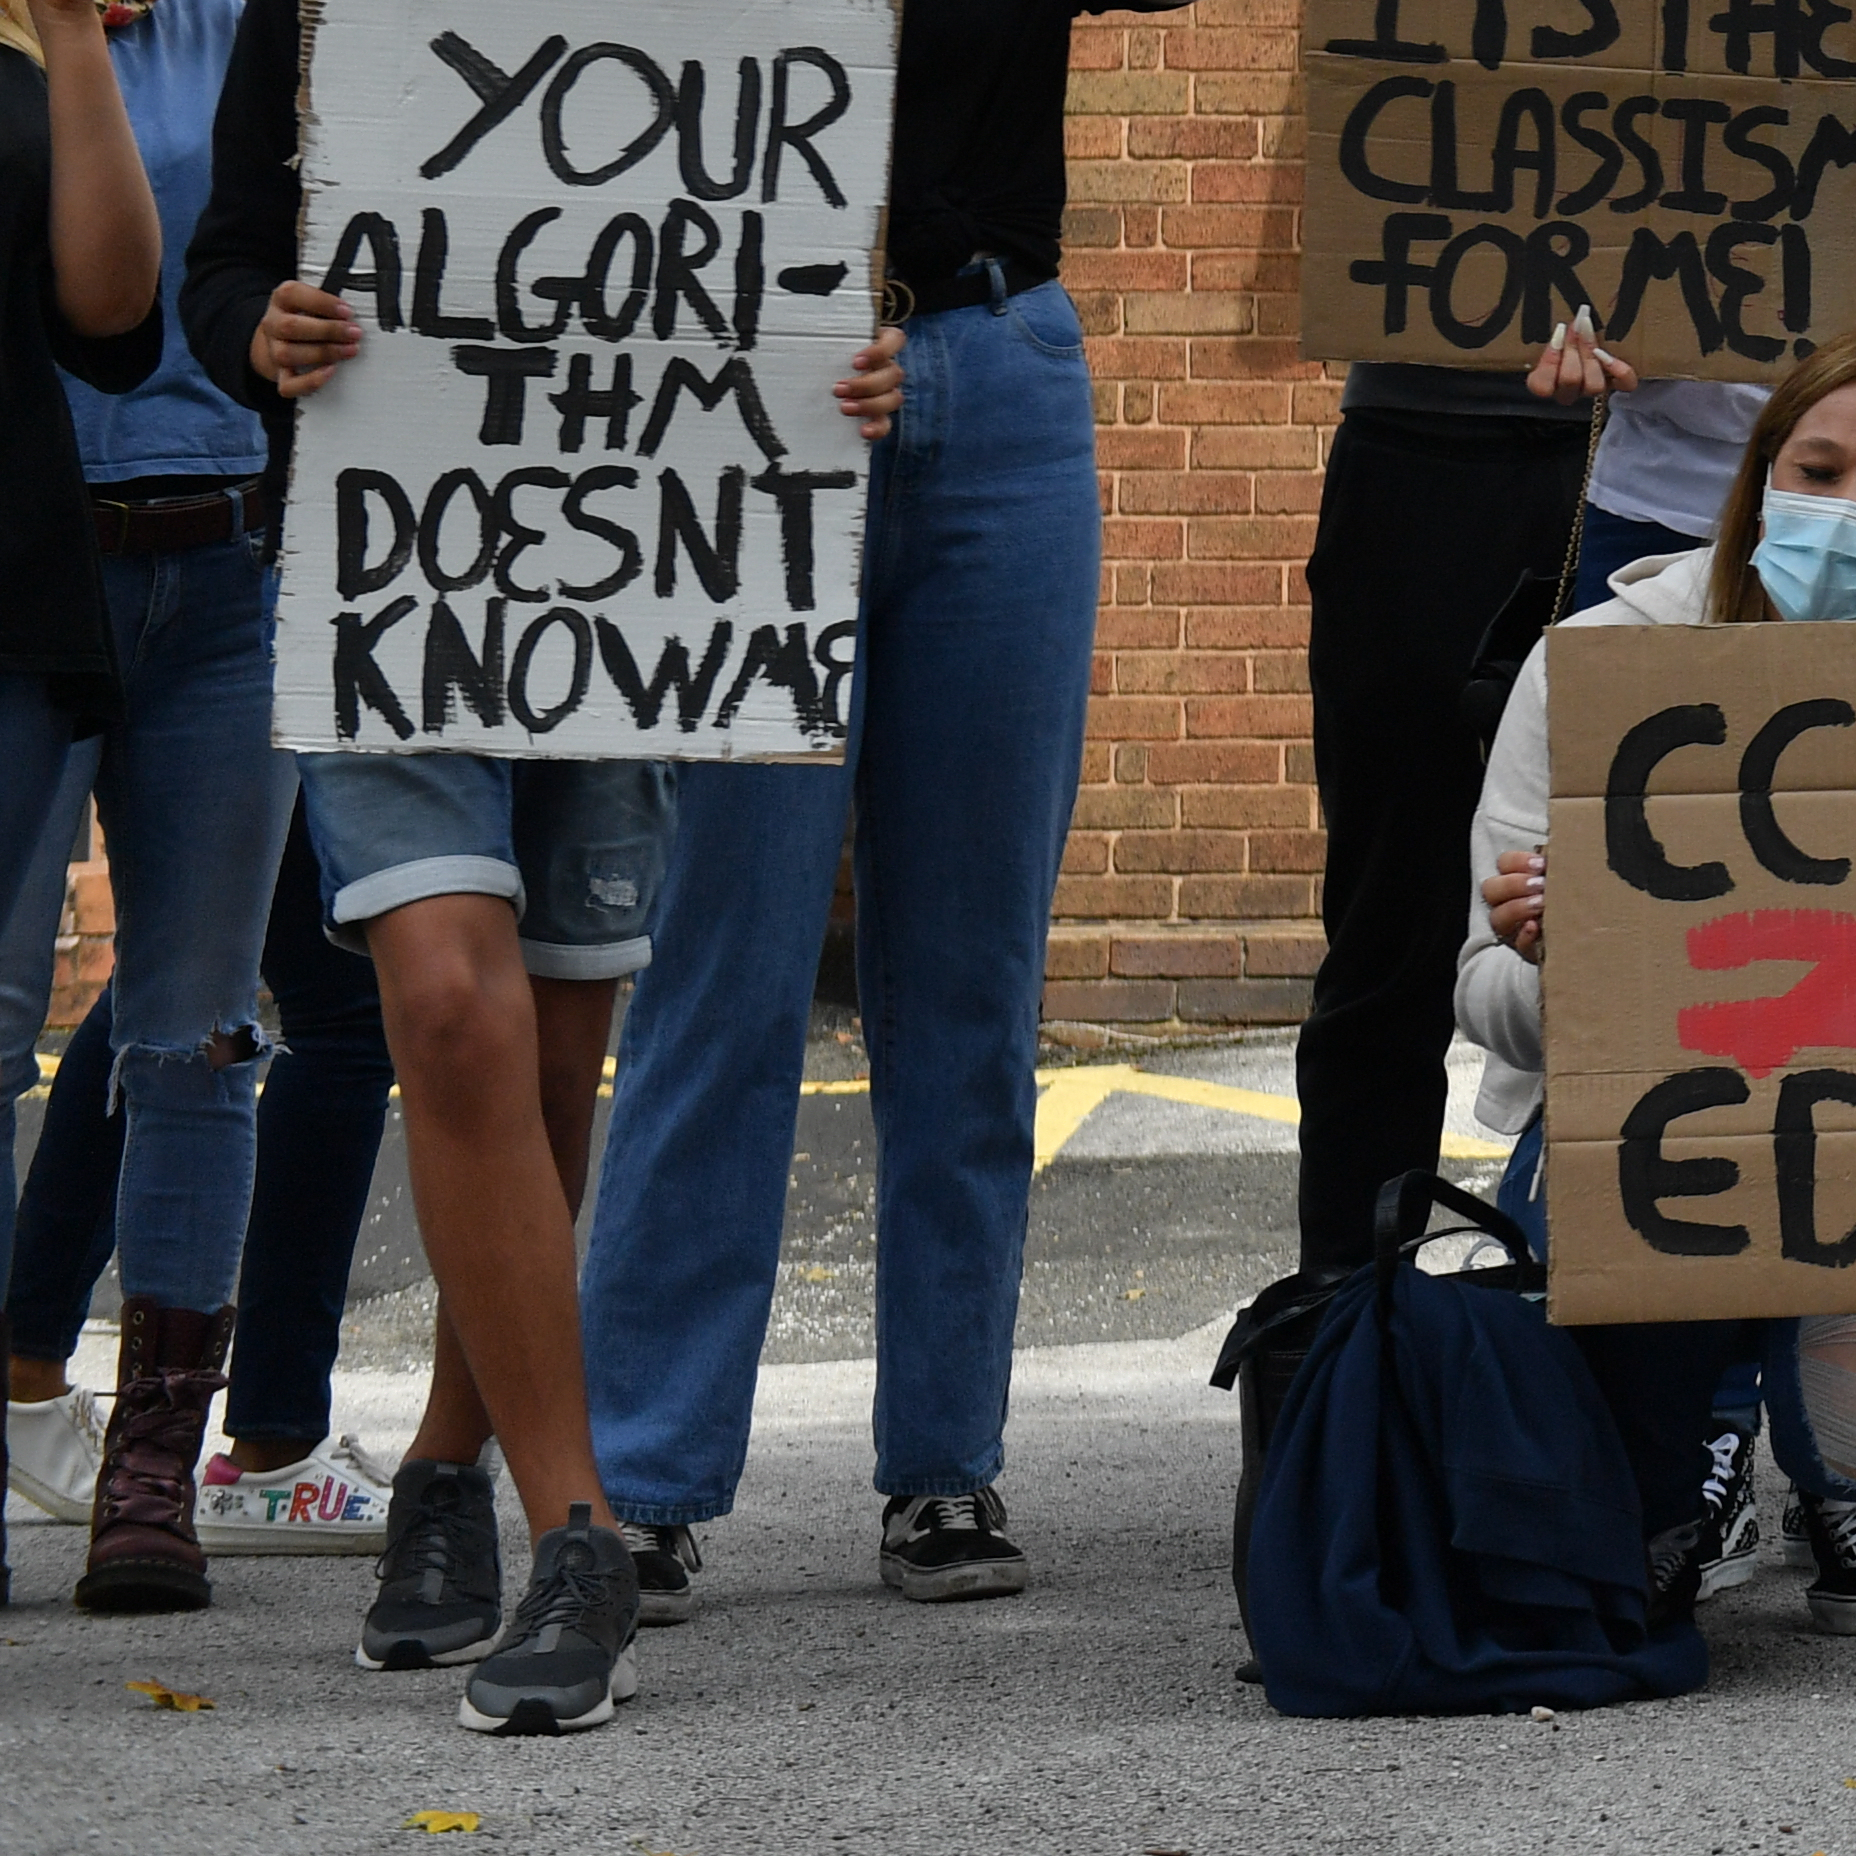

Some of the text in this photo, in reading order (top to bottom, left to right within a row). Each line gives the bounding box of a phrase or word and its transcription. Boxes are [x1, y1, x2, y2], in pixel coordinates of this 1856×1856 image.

[419, 29, 853, 209] YOUR
[1349, 212, 1604, 350] FOR
[450, 345, 790, 459] THM
